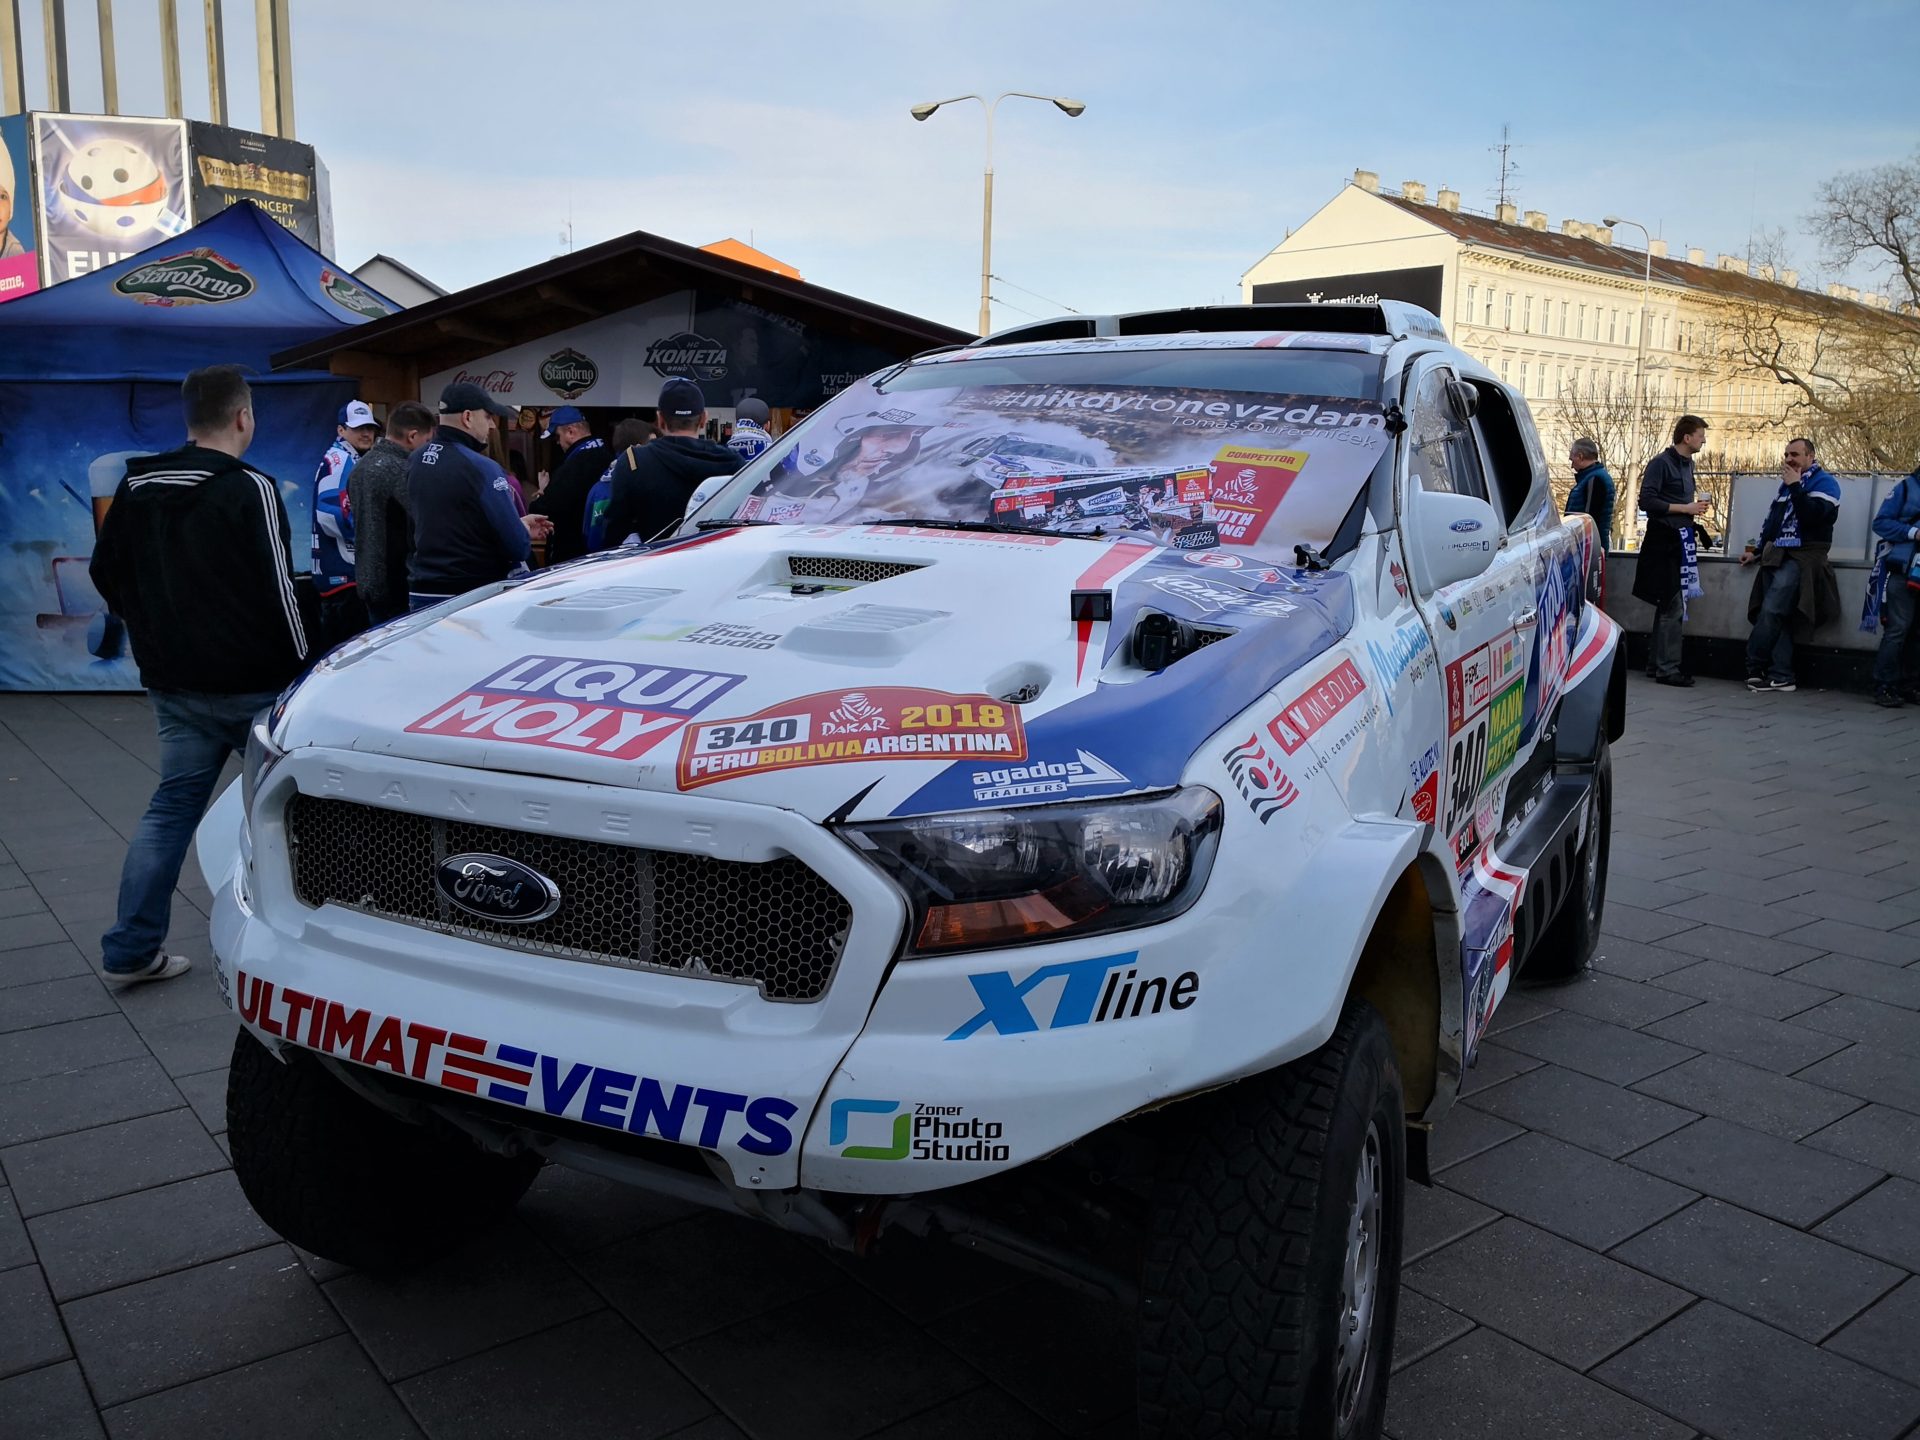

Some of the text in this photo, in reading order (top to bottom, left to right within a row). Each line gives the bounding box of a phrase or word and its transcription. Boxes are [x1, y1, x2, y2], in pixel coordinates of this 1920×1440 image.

[224, 193, 294, 215] IN ONCERT
[125, 265, 243, 299] Starobrno
[648, 349, 727, 364] KOMETA
[452, 370, 518, 393] Coca-Cola
[545, 362, 595, 387] Starobrno
[1171, 415, 1240, 431] Tomáš
[1226, 450, 1296, 465] COMPETITOR
[1213, 488, 1255, 505] DAKAR
[1215, 509, 1255, 526] UTH
[1143, 577, 1299, 612] KOMETA
[695, 627, 783, 641] Photo
[709, 622, 756, 630] Zoner
[678, 634, 776, 650] Studio
[485, 658, 734, 710] LIQUI
[418, 694, 687, 752] MOLY
[901, 704, 1005, 729] 2018
[1489, 685, 1523, 742] MANN
[707, 719, 798, 750] 340
[822, 717, 890, 736] DAKAR
[1485, 722, 1521, 781] FILTER
[973, 760, 1084, 789] agados
[1304, 750, 1331, 780] visual
[979, 783, 1064, 800] TRAILERS
[1446, 721, 1487, 840] 340
[454, 862, 523, 909] Ford
[944, 950, 1200, 1041] XTline
[915, 1103, 964, 1116] Zoner
[913, 1117, 1003, 1138] Photo
[912, 1140, 1010, 1161] Studio
